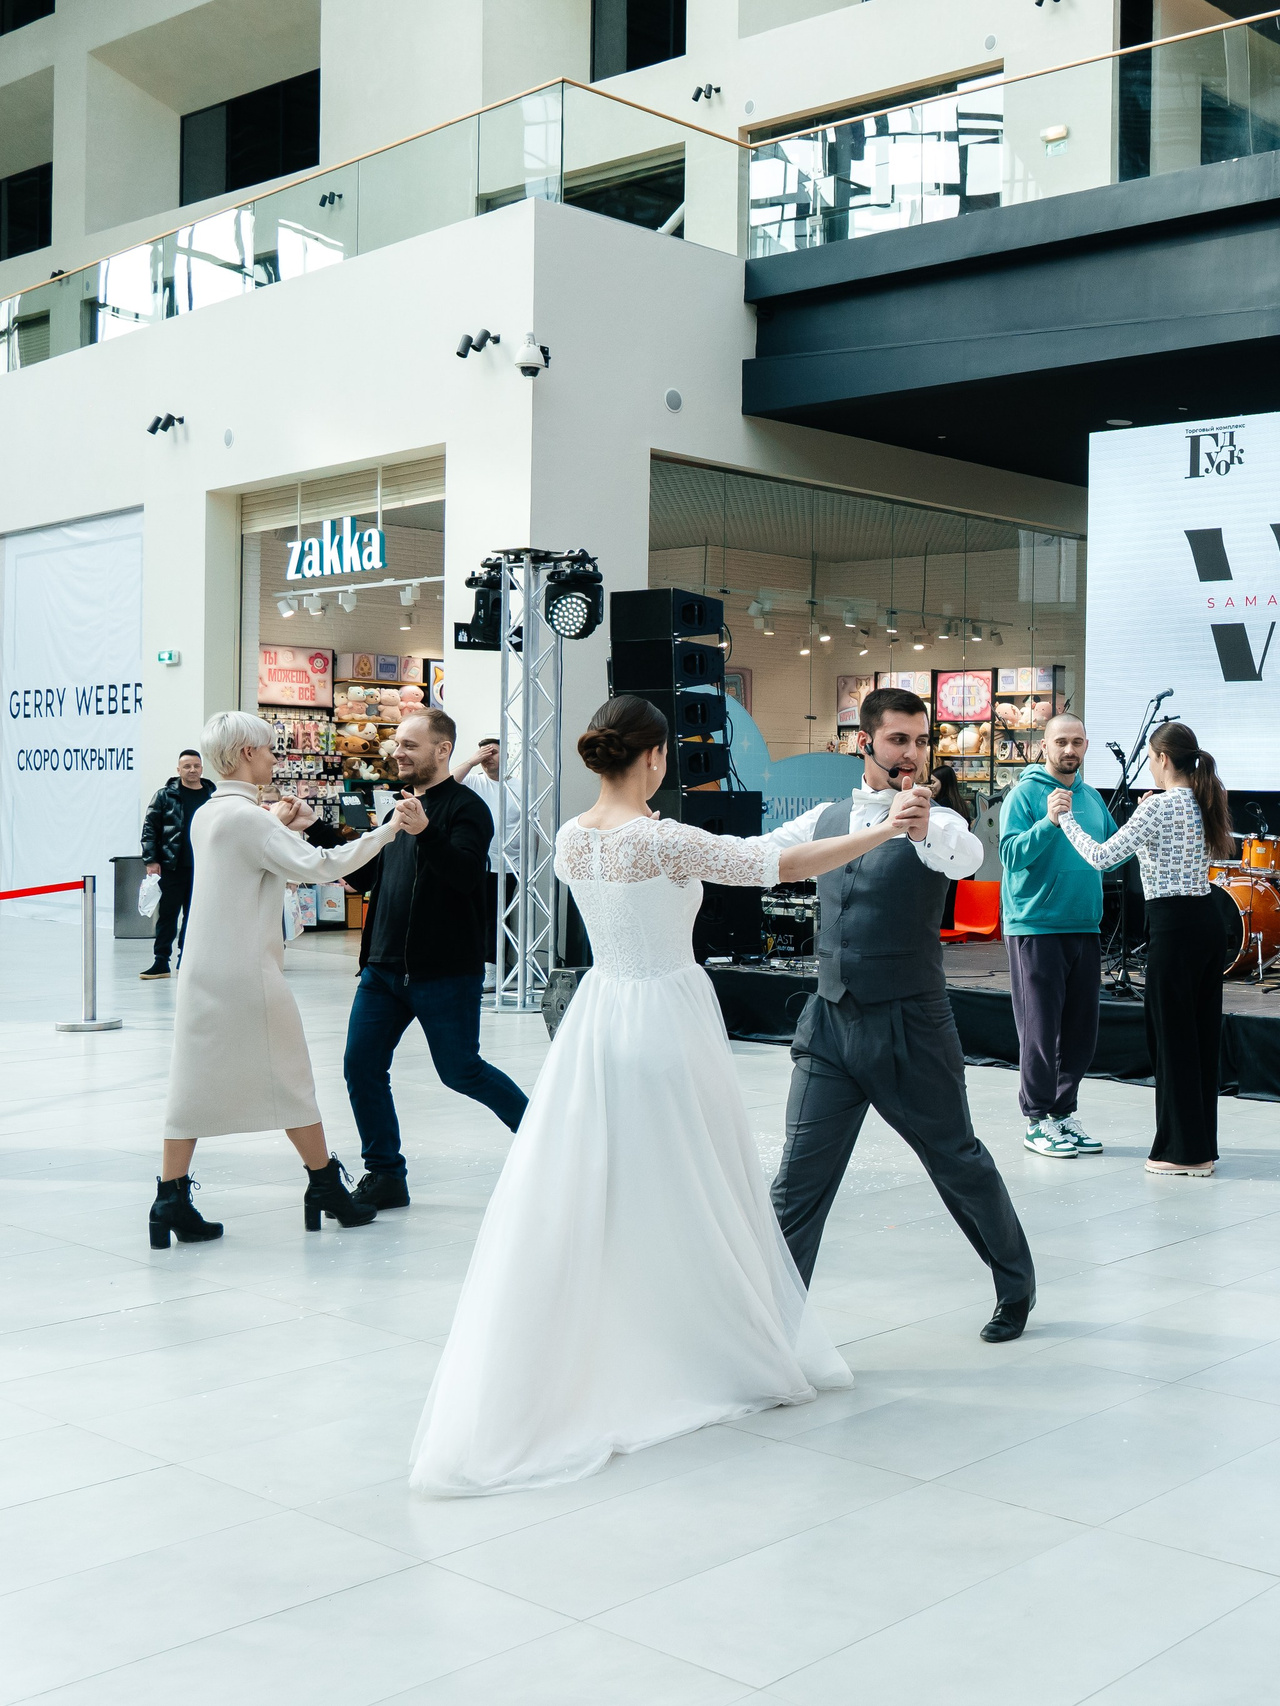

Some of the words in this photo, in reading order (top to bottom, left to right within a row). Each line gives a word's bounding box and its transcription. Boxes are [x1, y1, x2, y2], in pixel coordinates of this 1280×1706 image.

[1185, 426, 1214, 434] Торговый
[1215, 423, 1246, 431] комплекс
[286, 516, 388, 581] zakka
[263, 651, 278, 665] ТЫ
[268, 668, 311, 684] МОЖЕШЬ
[9, 687, 67, 719] GERRY
[75, 682, 143, 716] WEBER
[298, 685, 316, 701] ВСЁ
[17, 748, 60, 771] СКОРО
[63, 747, 134, 771] ОТКРЫТИЕ
